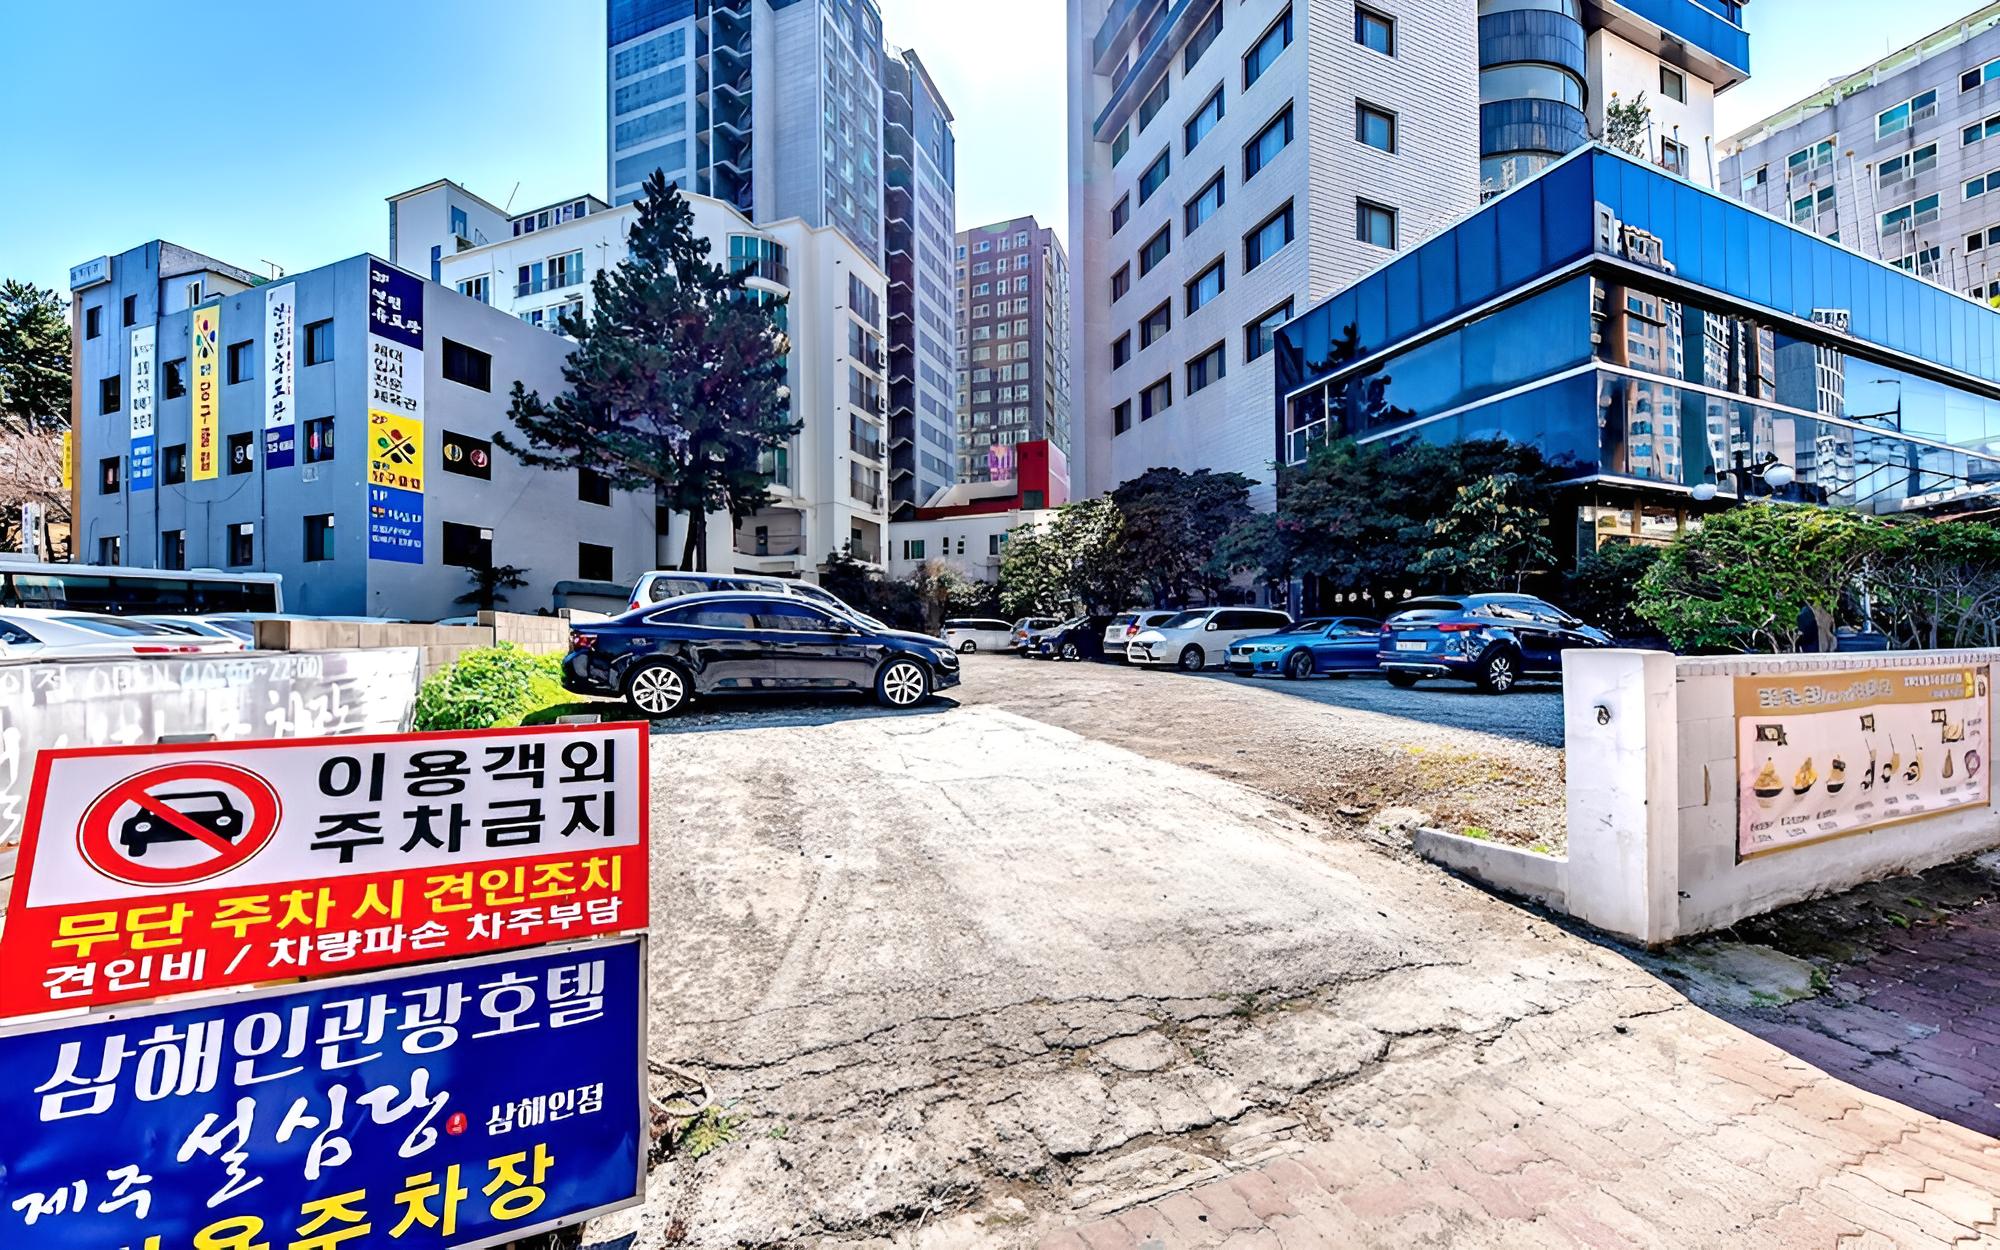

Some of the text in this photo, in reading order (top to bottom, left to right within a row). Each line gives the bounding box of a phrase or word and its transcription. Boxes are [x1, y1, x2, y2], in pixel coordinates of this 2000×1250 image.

[310, 793, 615, 864] 주차금지
[41, 948, 207, 1000] 견인비
[267, 920, 449, 968] 차량파손
[467, 897, 623, 941] 차주부담
[51, 855, 622, 958] 무단 주차 시 견인조치
[34, 959, 606, 1121] 삼해인관광호텔
[12, 1067, 603, 1225] 제주 설심당 삼해인점
